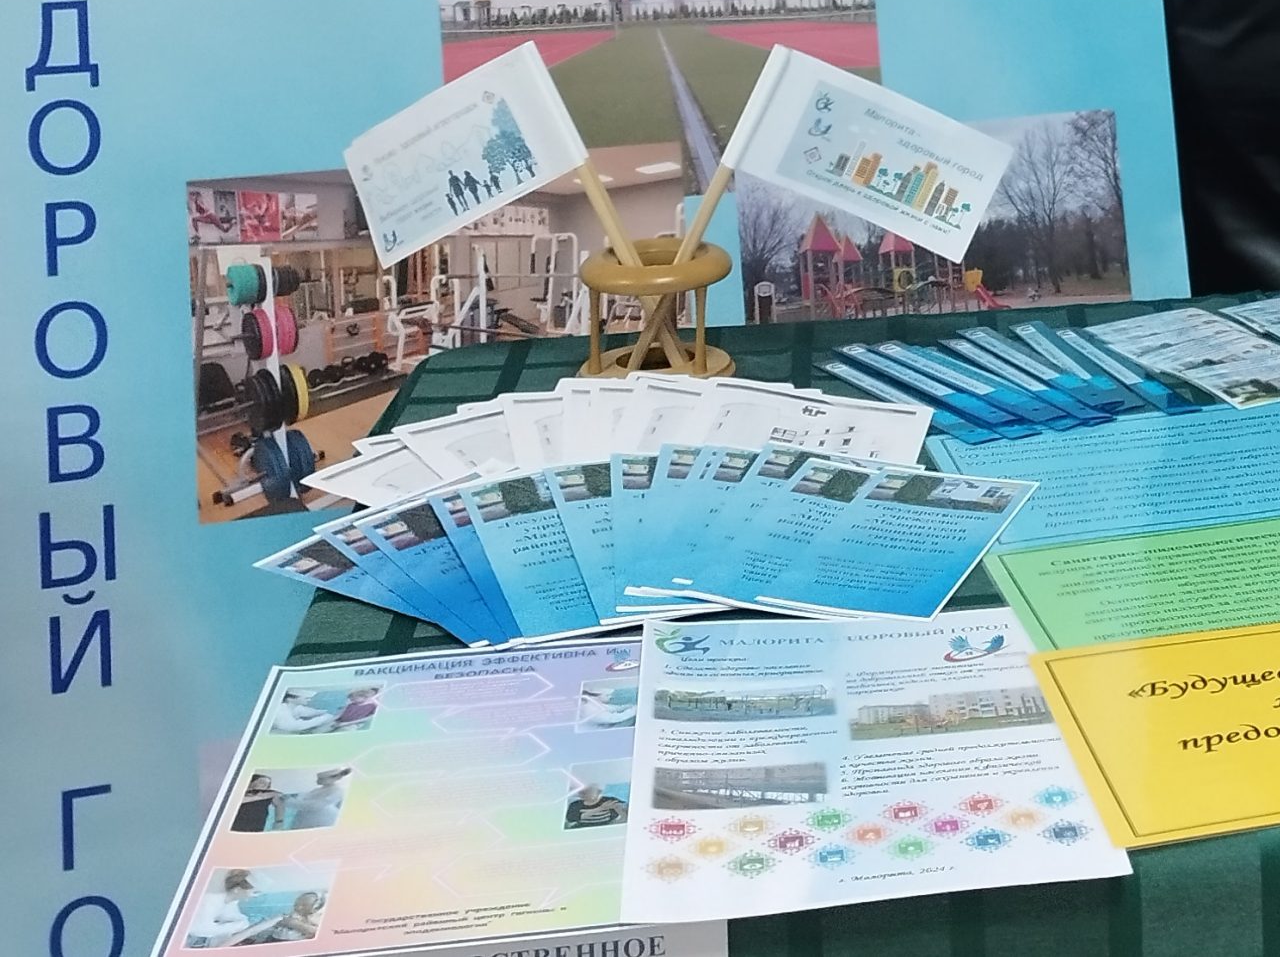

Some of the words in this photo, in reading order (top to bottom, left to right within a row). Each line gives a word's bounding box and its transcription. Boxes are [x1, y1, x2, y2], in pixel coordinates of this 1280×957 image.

[863, 107, 917, 137] Малорита
[719, 636, 824, 646] МАЛОРИТА
[847, 627, 945, 643] ДОРОВЫЙ
[354, 660, 472, 675] ВАКЦИНАЦИЯ
[481, 650, 597, 665] ЭФФЕКТИВНА
[433, 665, 536, 678] БЕЗОПАСНА
